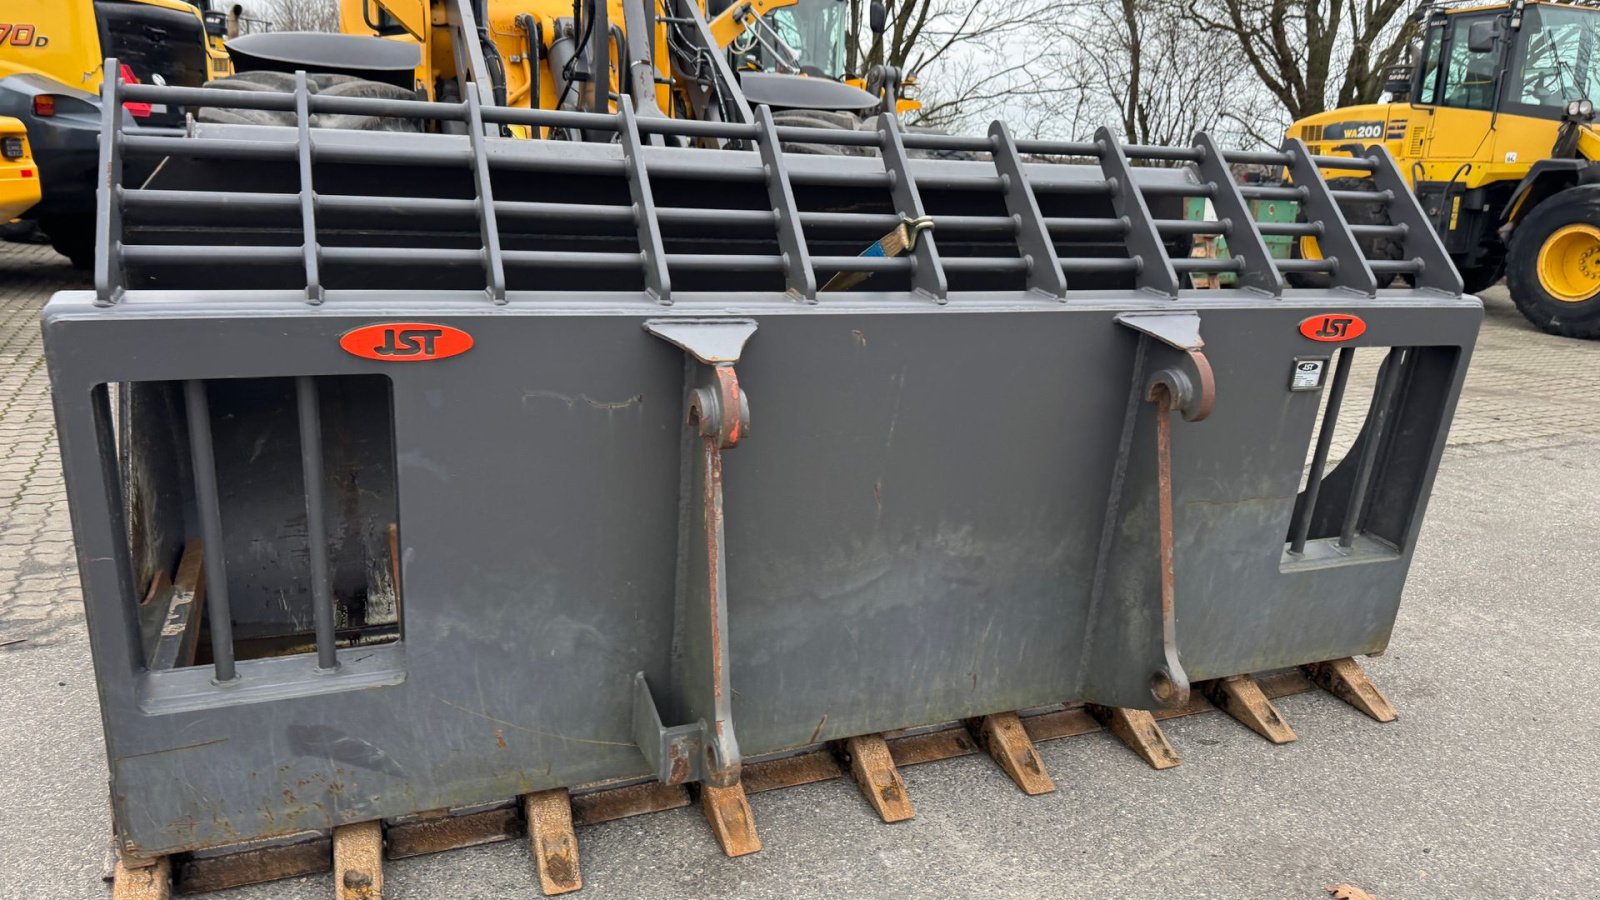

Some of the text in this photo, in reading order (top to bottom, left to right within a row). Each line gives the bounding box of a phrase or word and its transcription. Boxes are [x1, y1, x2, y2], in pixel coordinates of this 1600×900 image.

[1344, 125, 1381, 139] WA200
[1315, 318, 1353, 337] JST
[373, 329, 443, 355] JST
